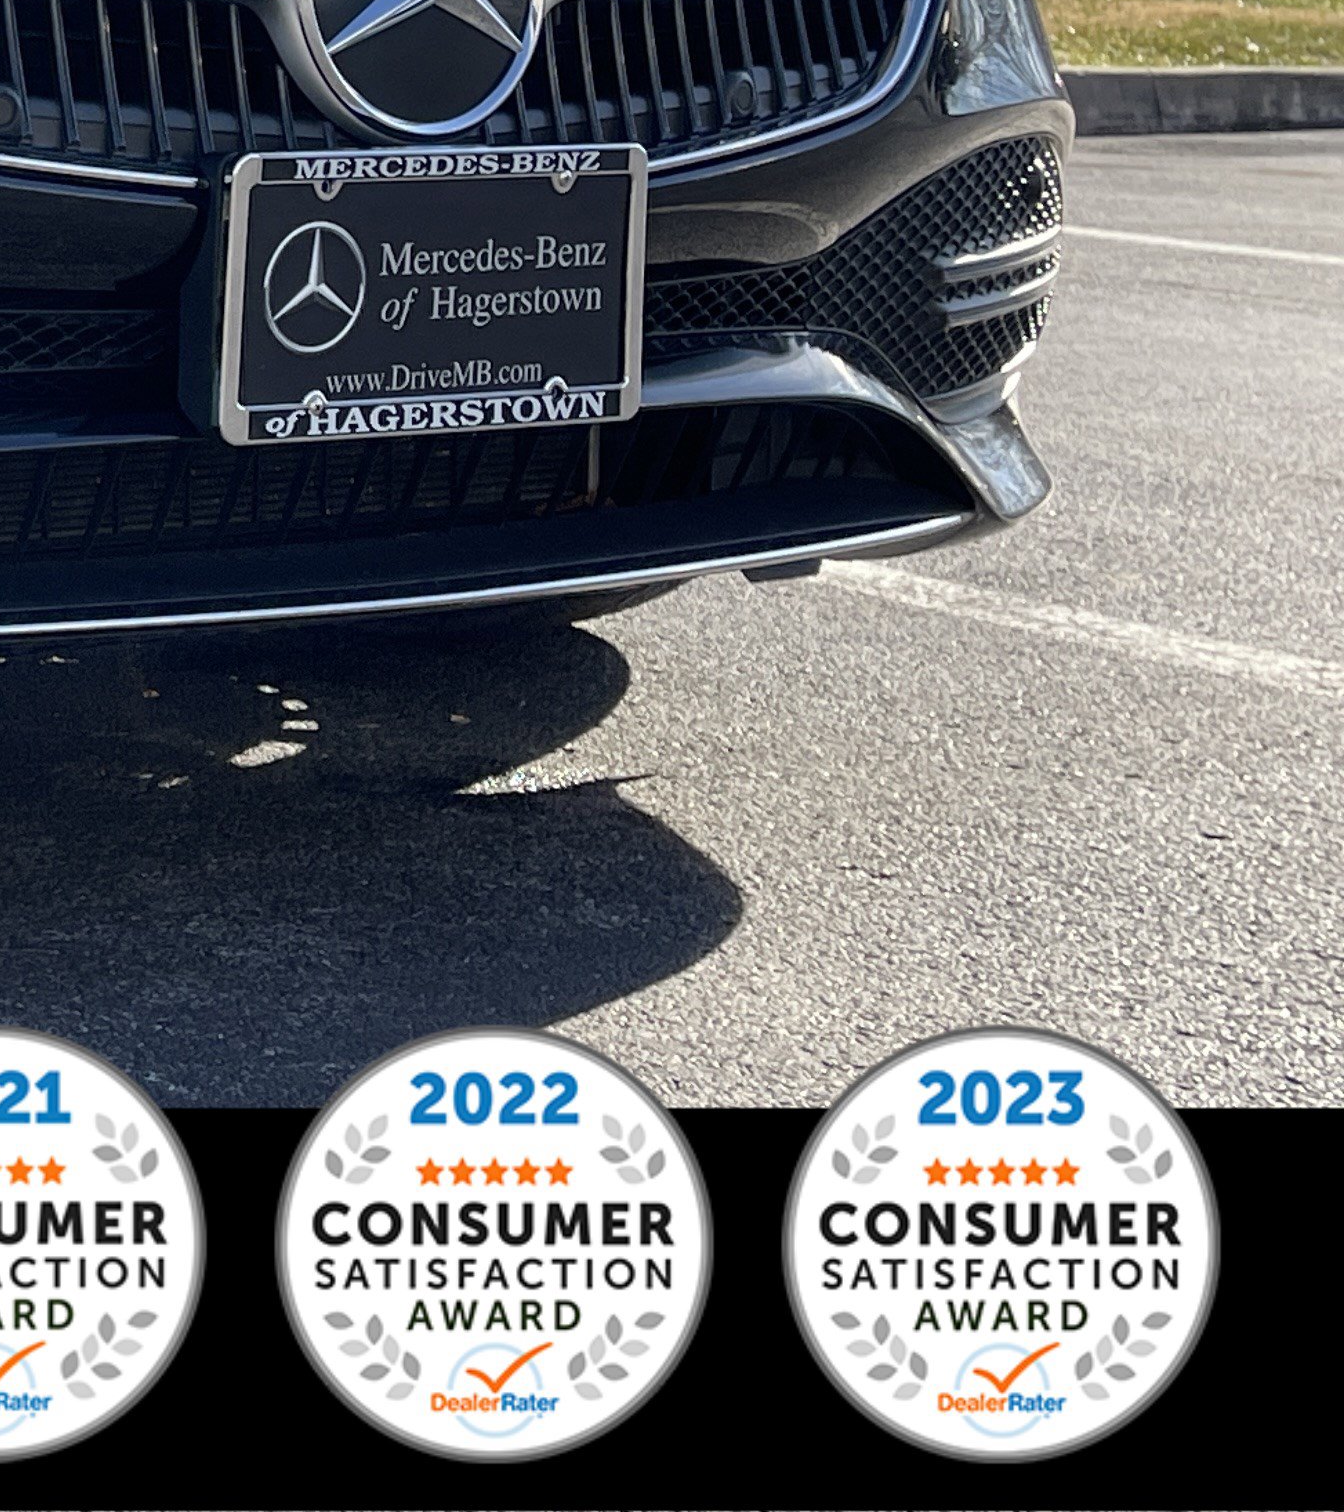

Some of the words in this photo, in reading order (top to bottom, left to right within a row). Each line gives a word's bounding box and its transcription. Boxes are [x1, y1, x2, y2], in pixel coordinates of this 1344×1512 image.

[294, 151, 601, 180] MERCEDES-BENZ
[379, 235, 607, 277] Mercedes-Benz
[380, 287, 419, 331] of
[431, 286, 602, 327] Hagerstown
[326, 360, 543, 394] www.DriveMB.com
[265, 409, 305, 438] of
[305, 391, 607, 436] HAGERSTOWN
